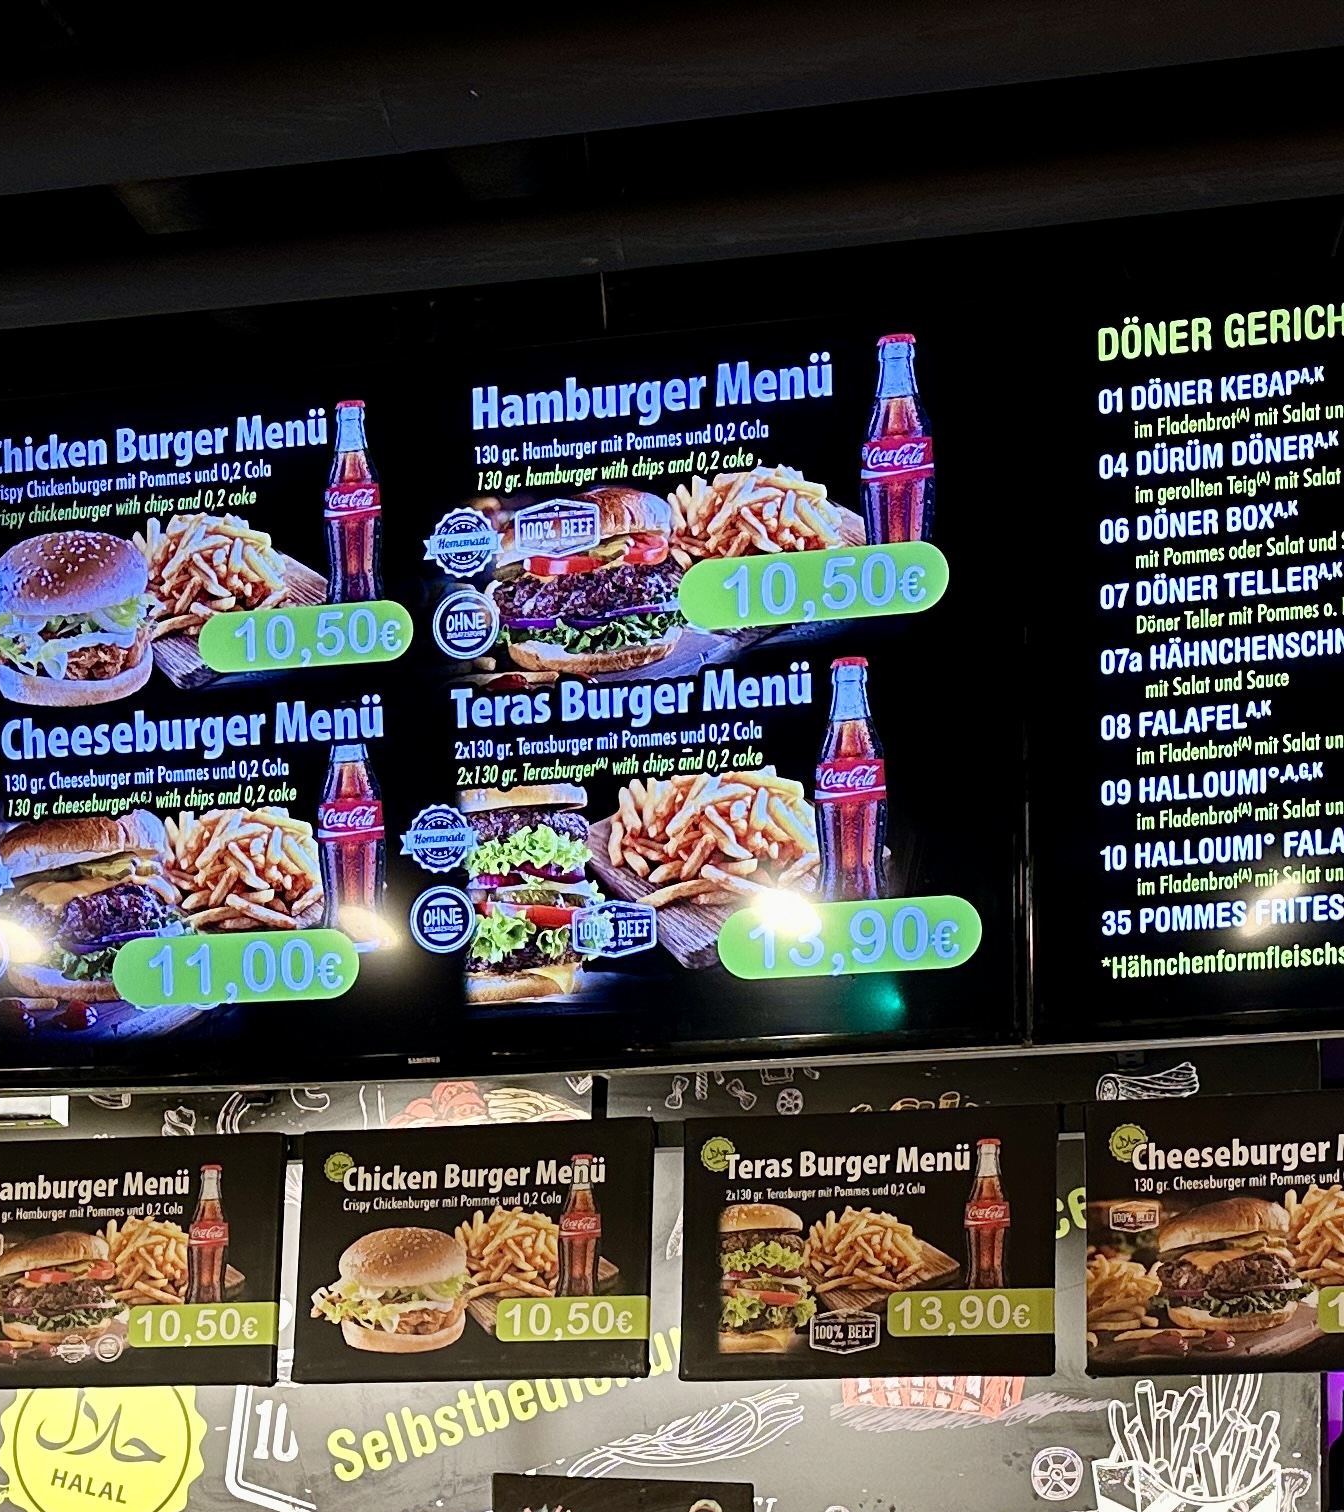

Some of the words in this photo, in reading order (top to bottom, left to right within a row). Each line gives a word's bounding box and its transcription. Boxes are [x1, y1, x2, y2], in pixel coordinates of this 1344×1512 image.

[1097, 316, 1212, 362] DÖNER
[472, 374, 707, 431] Hamburger
[716, 351, 834, 406] Menü
[1098, 388, 1124, 414] 01
[1131, 378, 1213, 411] DÖNER
[116, 425, 228, 468] Burger
[235, 407, 328, 453] Menü
[475, 445, 498, 465] 130
[502, 446, 519, 467] gr.
[523, 437, 598, 462] Hamburger
[601, 432, 622, 453] mit
[626, 430, 681, 452] Pommes
[685, 426, 711, 445] und
[715, 424, 735, 444] 0,2
[740, 421, 769, 441] Cola
[1099, 453, 1129, 480] 04
[1136, 440, 1224, 477] DÜRÜM
[1135, 548, 1158, 569] mit
[1164, 544, 1224, 567] Pommes
[1229, 541, 1262, 560] oder
[1266, 535, 1304, 557] Salat
[1309, 533, 1334, 552] und
[723, 551, 927, 622] 10,50€
[234, 607, 401, 668] 10,50€
[446, 612, 485, 631] OHNE
[450, 682, 551, 730] Teras
[561, 677, 694, 728] Burger
[703, 661, 813, 710] Menü
[1, 711, 266, 761] Cheeseburger
[275, 693, 384, 744] Menü
[1101, 910, 1131, 935] 35
[1139, 903, 1247, 933] POMMES
[1256, 894, 1344, 925] FRITES
[148, 939, 343, 1003] 11,00€
[726, 1151, 793, 1179] Teras
[800, 1151, 893, 1182] Burger
[896, 1144, 970, 1173] Menü
[1132, 1138, 1331, 1171] Cheeseburger
[123, 1170, 190, 1197] Menü
[342, 1166, 437, 1192] Chicken
[444, 1163, 531, 1193] Burger
[535, 1158, 606, 1184] Menü
[1134, 1178, 1153, 1193] 130
[1156, 1181, 1169, 1194] gr.
[1173, 1175, 1245, 1191] Cheeseburger
[1249, 1174, 1267, 1188] mit
[1270, 1172, 1316, 1186] Pommes
[1319, 1170, 1340, 1184] und
[136, 1308, 258, 1346] 10,50€
[505, 1301, 633, 1340] 10,50€
[814, 1324, 843, 1340] 100%
[848, 1323, 876, 1338] BEEF
[893, 1295, 1031, 1336] 13,90€
[51, 1469, 128, 1505] HALAL
